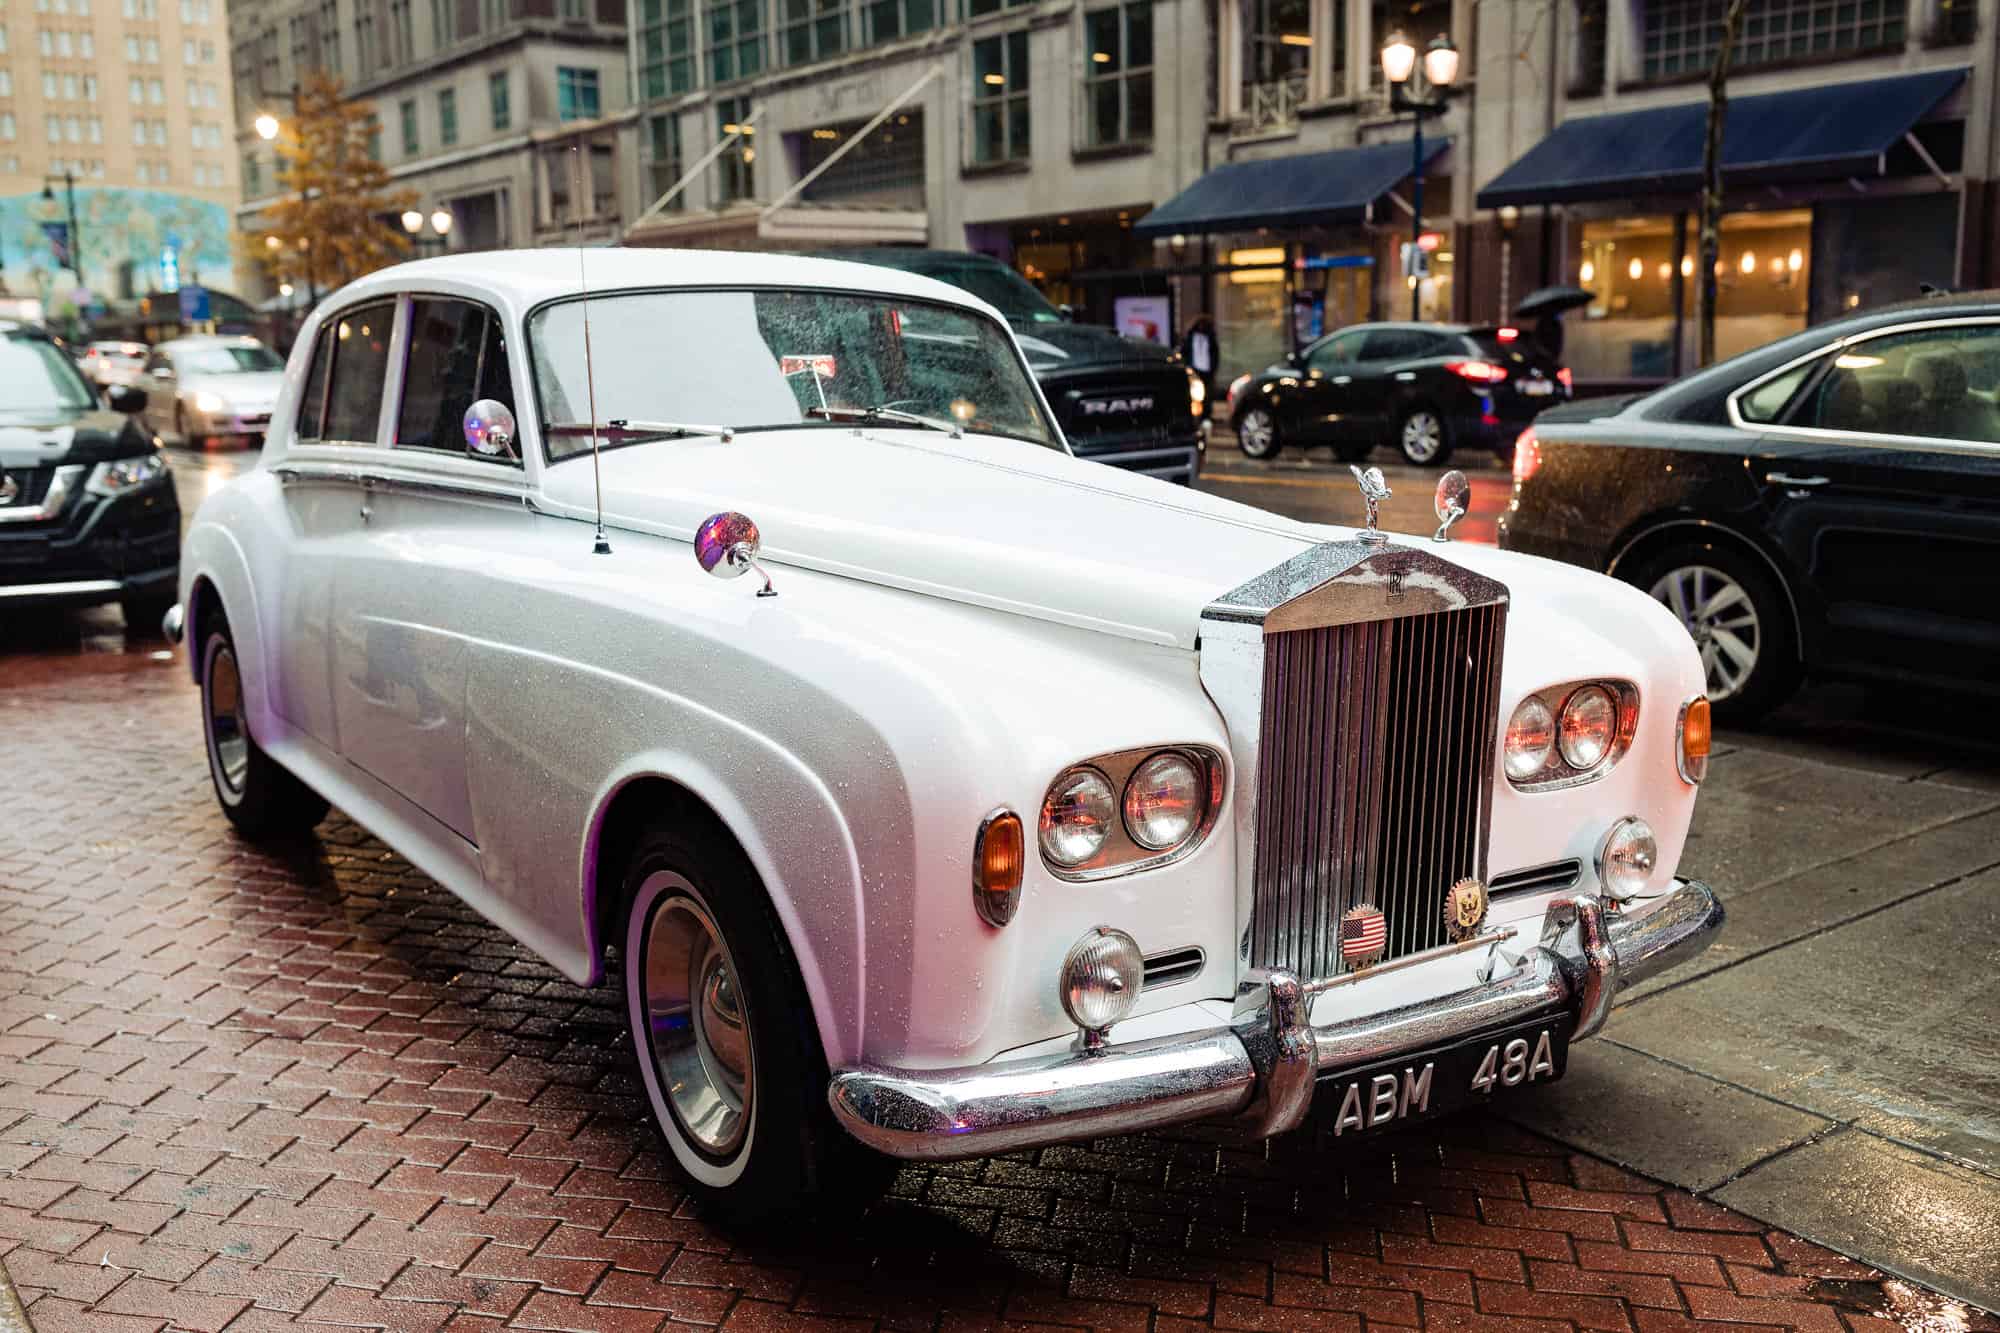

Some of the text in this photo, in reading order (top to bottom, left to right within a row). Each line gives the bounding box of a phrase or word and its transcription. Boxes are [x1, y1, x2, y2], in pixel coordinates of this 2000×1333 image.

[1080, 398, 1153, 414] RAM
[1334, 1030, 1553, 1136] ABM 48A
